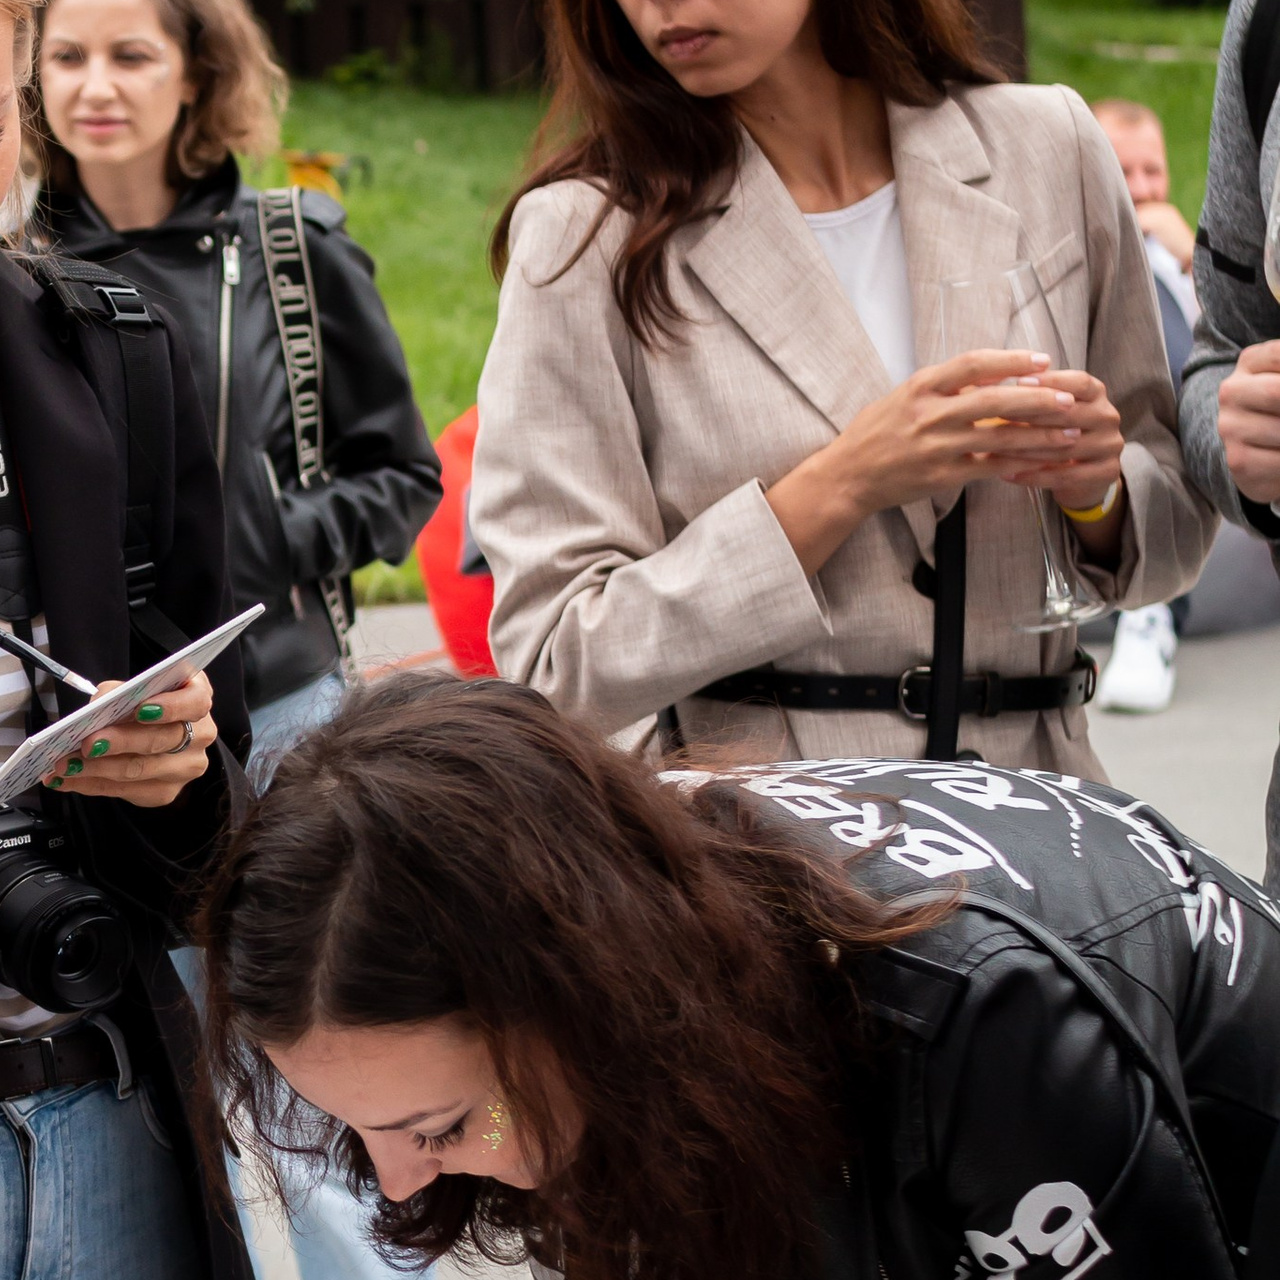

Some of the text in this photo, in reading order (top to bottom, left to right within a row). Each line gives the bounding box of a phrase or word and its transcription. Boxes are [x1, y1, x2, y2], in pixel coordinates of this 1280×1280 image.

[268, 227, 302, 264] TO
[275, 272, 310, 315] UP
[286, 323, 317, 386] YOU
[48, 835, 65, 849] EOS
